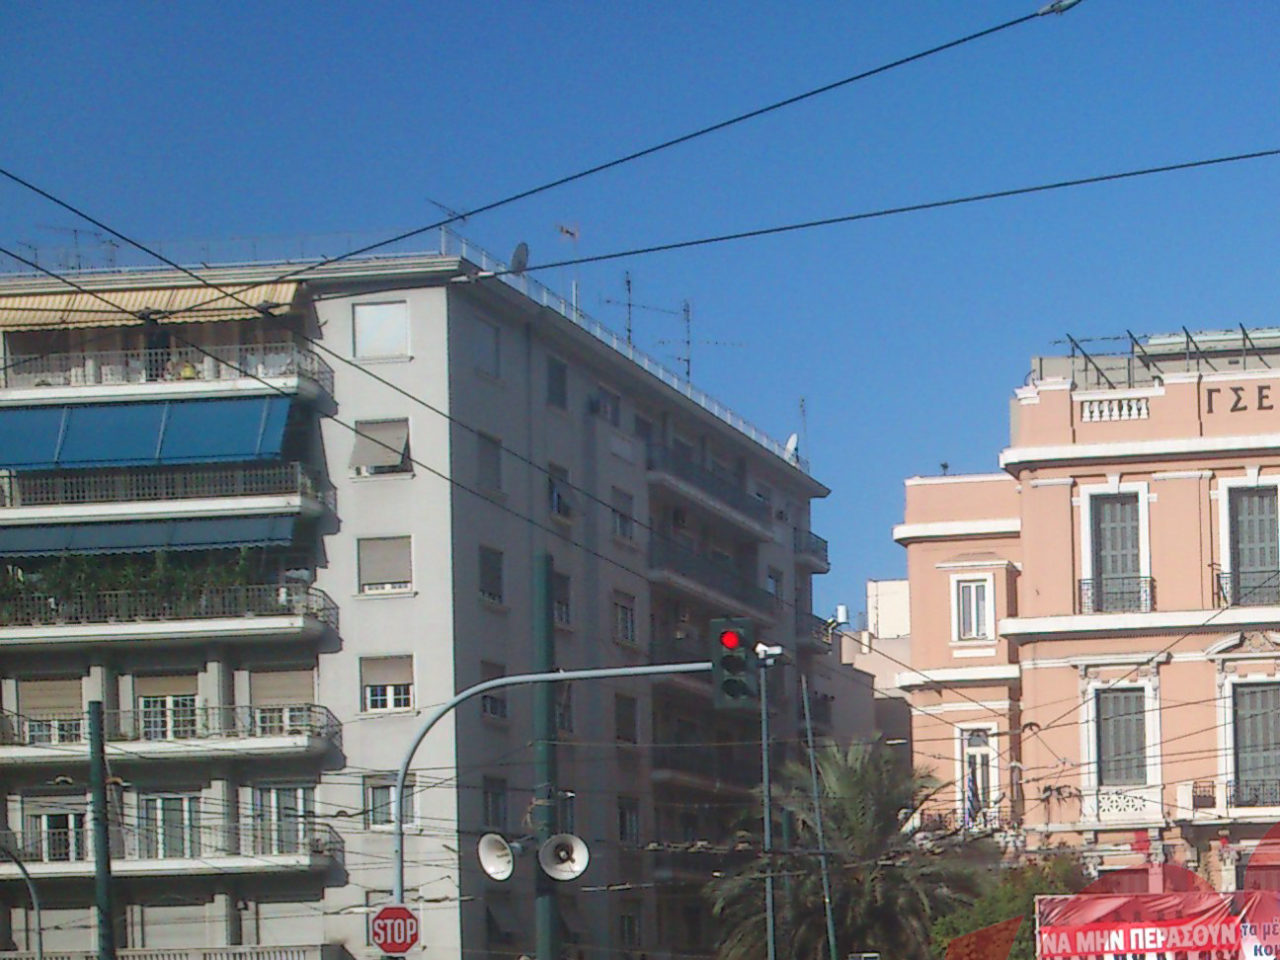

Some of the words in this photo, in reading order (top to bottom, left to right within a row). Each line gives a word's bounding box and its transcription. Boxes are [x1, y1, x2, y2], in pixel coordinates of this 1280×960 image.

[374, 918, 417, 944] STOP
[1042, 932, 1072, 954] ΝΑ
[1076, 929, 1125, 953] ΜΗΝ
[1130, 923, 1236, 950] ΠΕΡΑΣΟΥΝ
